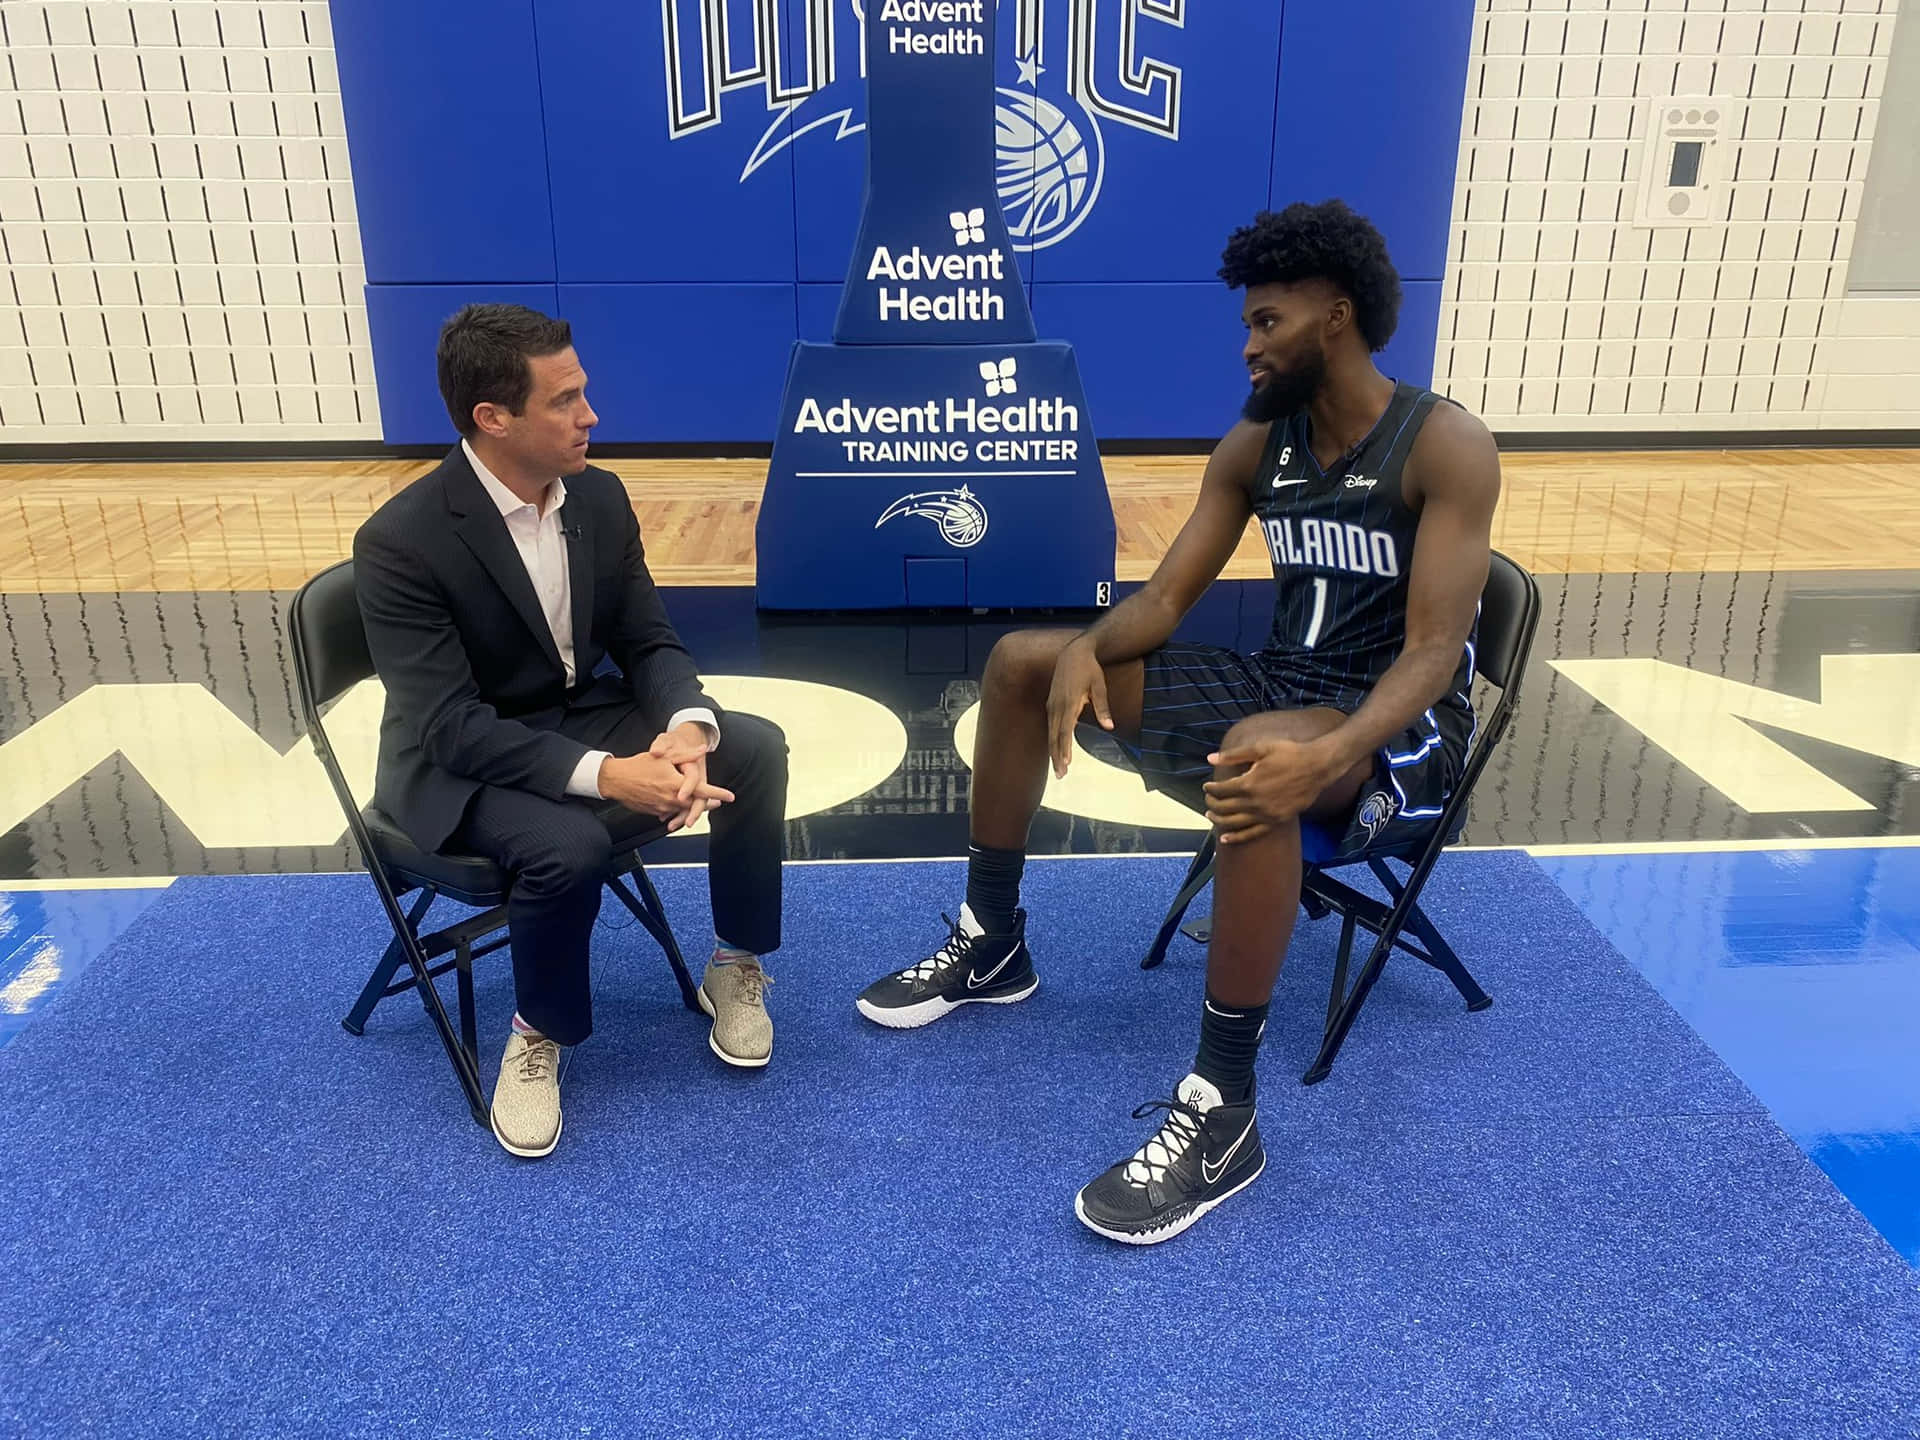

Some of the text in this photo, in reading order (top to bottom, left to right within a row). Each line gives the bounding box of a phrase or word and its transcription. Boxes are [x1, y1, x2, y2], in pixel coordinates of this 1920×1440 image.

[880, 0, 984, 22] Advent
[889, 27, 984, 54] Health
[866, 246, 1004, 281] Advent
[879, 287, 1004, 321] Health
[842, 439, 1078, 462] TRAINING CENTER
[1279, 446, 1292, 466] 6
[1260, 517, 1399, 577] RLANDO
[1099, 583, 1109, 605] 3
[1304, 577, 1328, 649] 1
